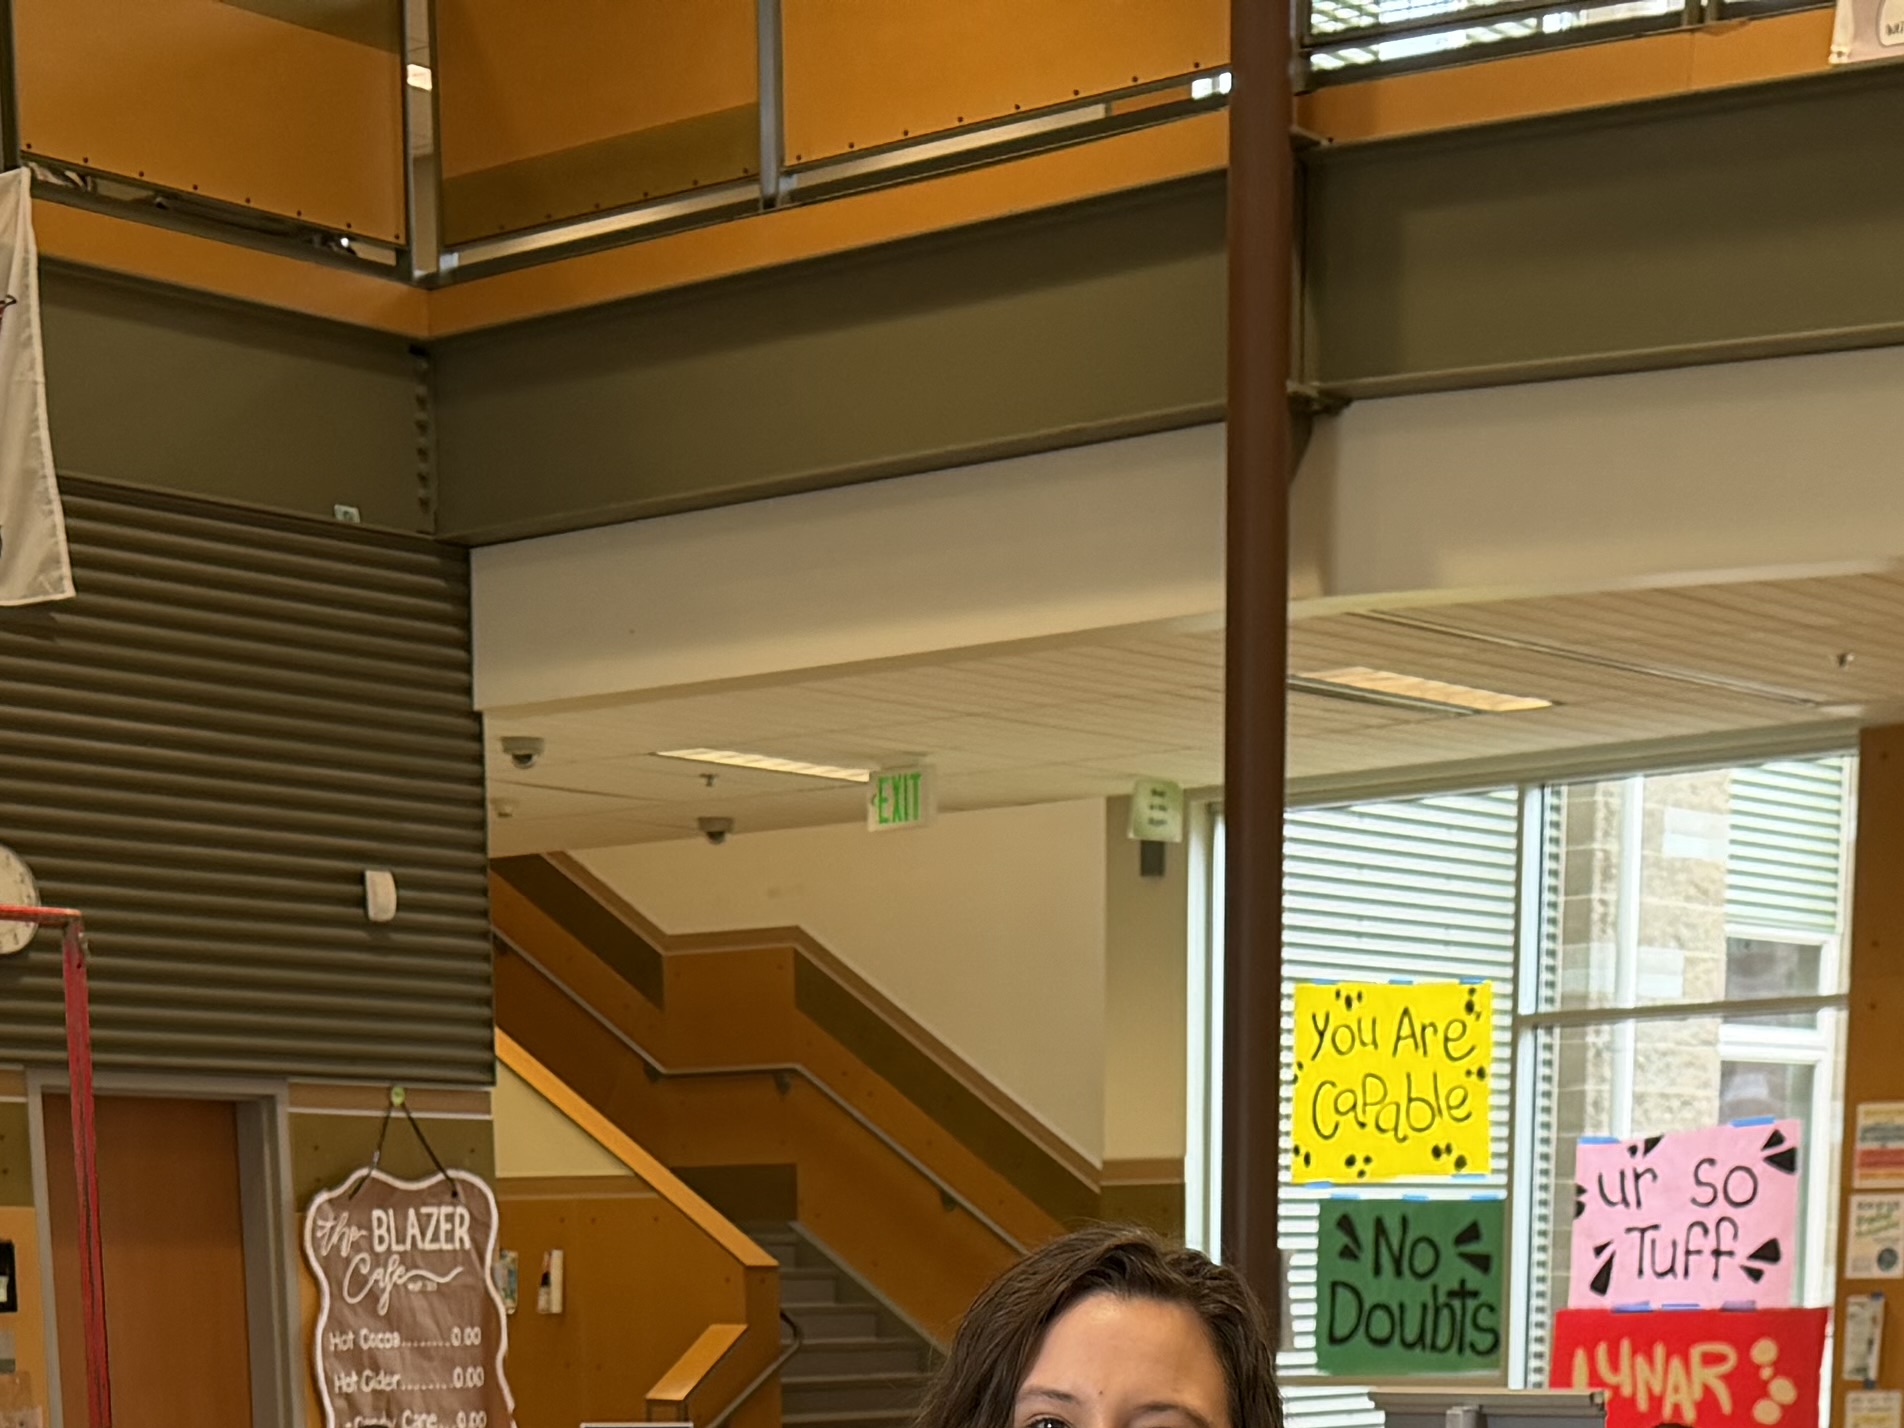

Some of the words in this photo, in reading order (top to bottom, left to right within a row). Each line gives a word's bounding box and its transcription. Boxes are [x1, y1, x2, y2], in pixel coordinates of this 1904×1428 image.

[878, 772, 921, 824] EXIT
[1311, 1012, 1379, 1063] You
[1392, 1005, 1477, 1062] Are
[1596, 1167, 1658, 1209] ur
[372, 1206, 471, 1252] BLAZER
[1371, 1215, 1441, 1281] No
[1624, 1215, 1739, 1282] Tuff
[330, 1330, 354, 1350] Hot
[1327, 1279, 1501, 1357] Doubts
[334, 1371, 358, 1394] Hot
